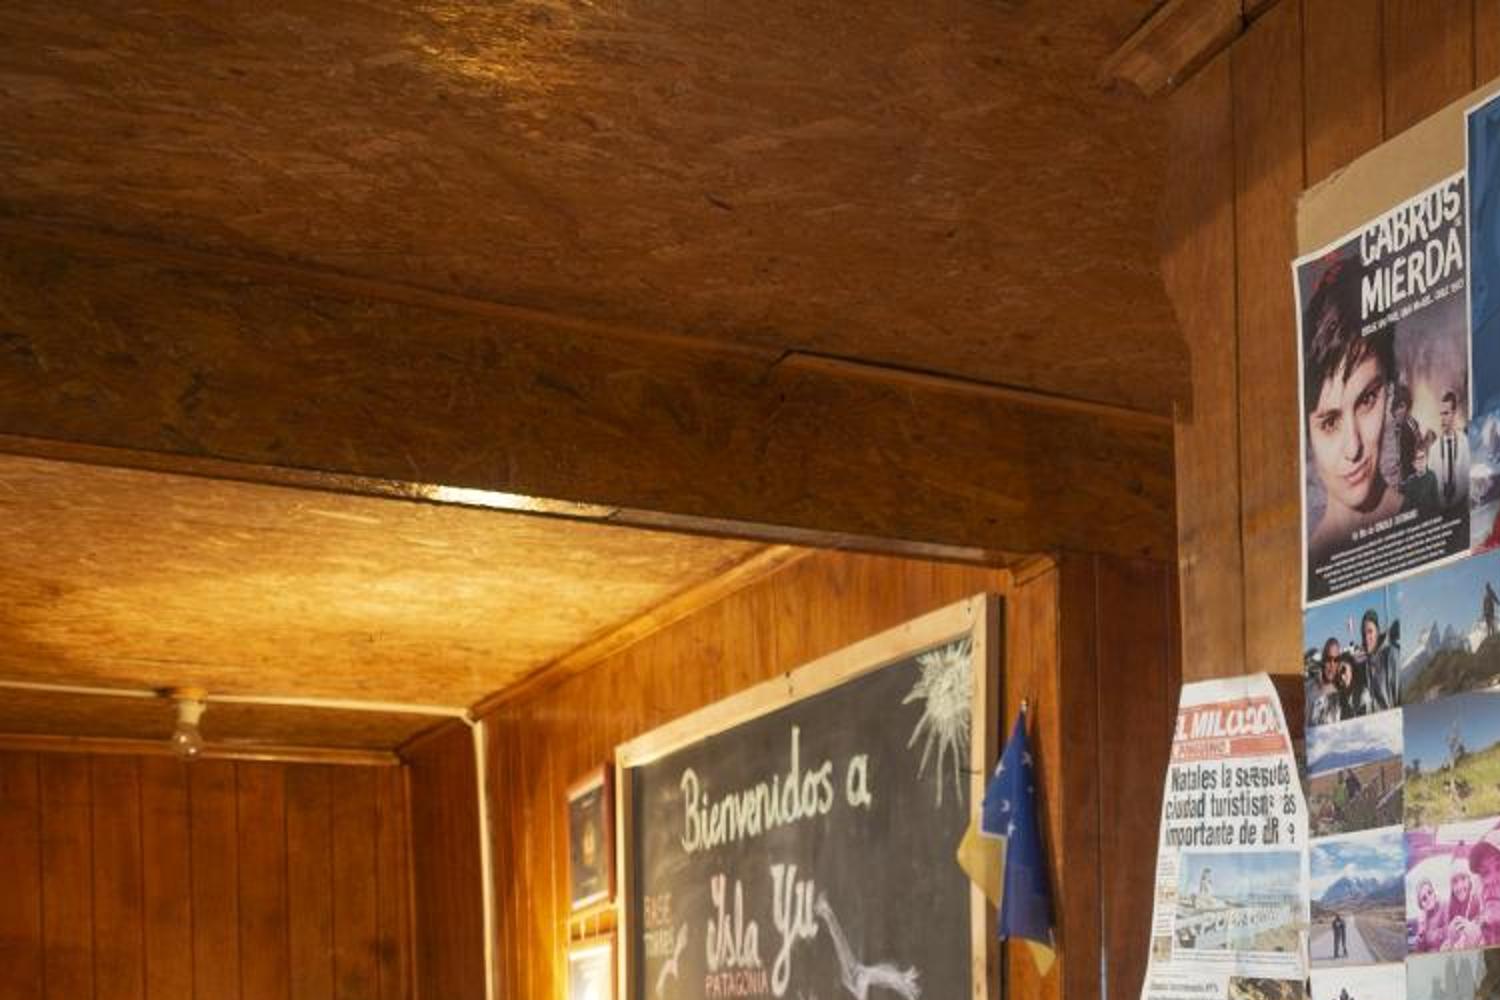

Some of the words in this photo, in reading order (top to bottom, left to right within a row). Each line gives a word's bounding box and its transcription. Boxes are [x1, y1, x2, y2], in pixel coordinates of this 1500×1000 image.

[1361, 227, 1463, 320] MIERDA
[681, 726, 833, 853] Bienvenidos
[846, 754, 871, 809] a
[1171, 764, 1217, 793] Natales
[1164, 792, 1206, 820] ciudad
[1164, 821, 1235, 848] importante
[706, 873, 761, 971] Isla
[770, 863, 819, 997] Yu
[704, 968, 772, 998] PATAGONIA
